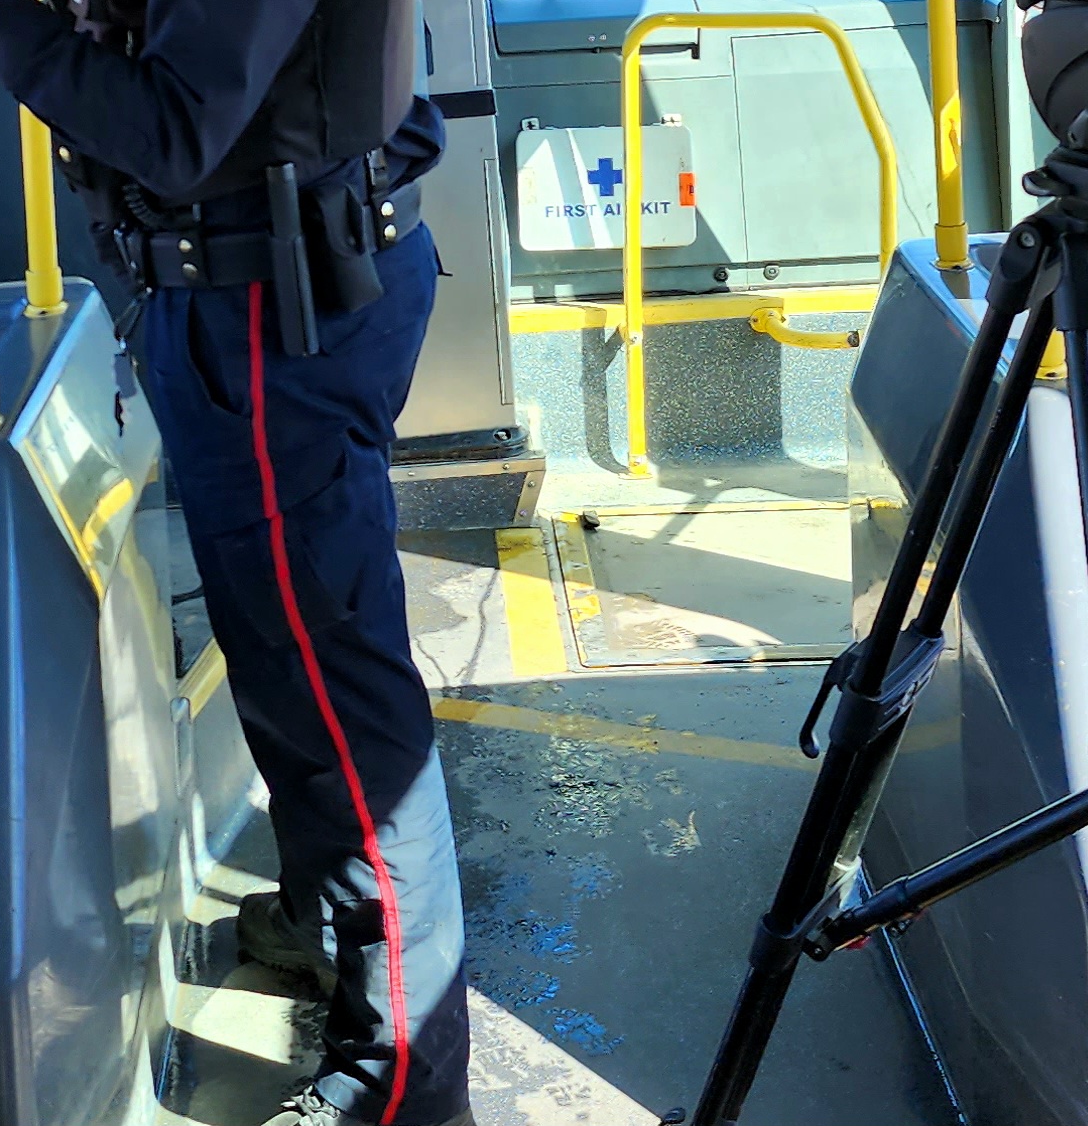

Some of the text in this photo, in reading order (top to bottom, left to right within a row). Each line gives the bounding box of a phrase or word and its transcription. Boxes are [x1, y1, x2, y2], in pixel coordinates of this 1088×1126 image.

[545, 201, 671, 218] FIRST AI KIT
